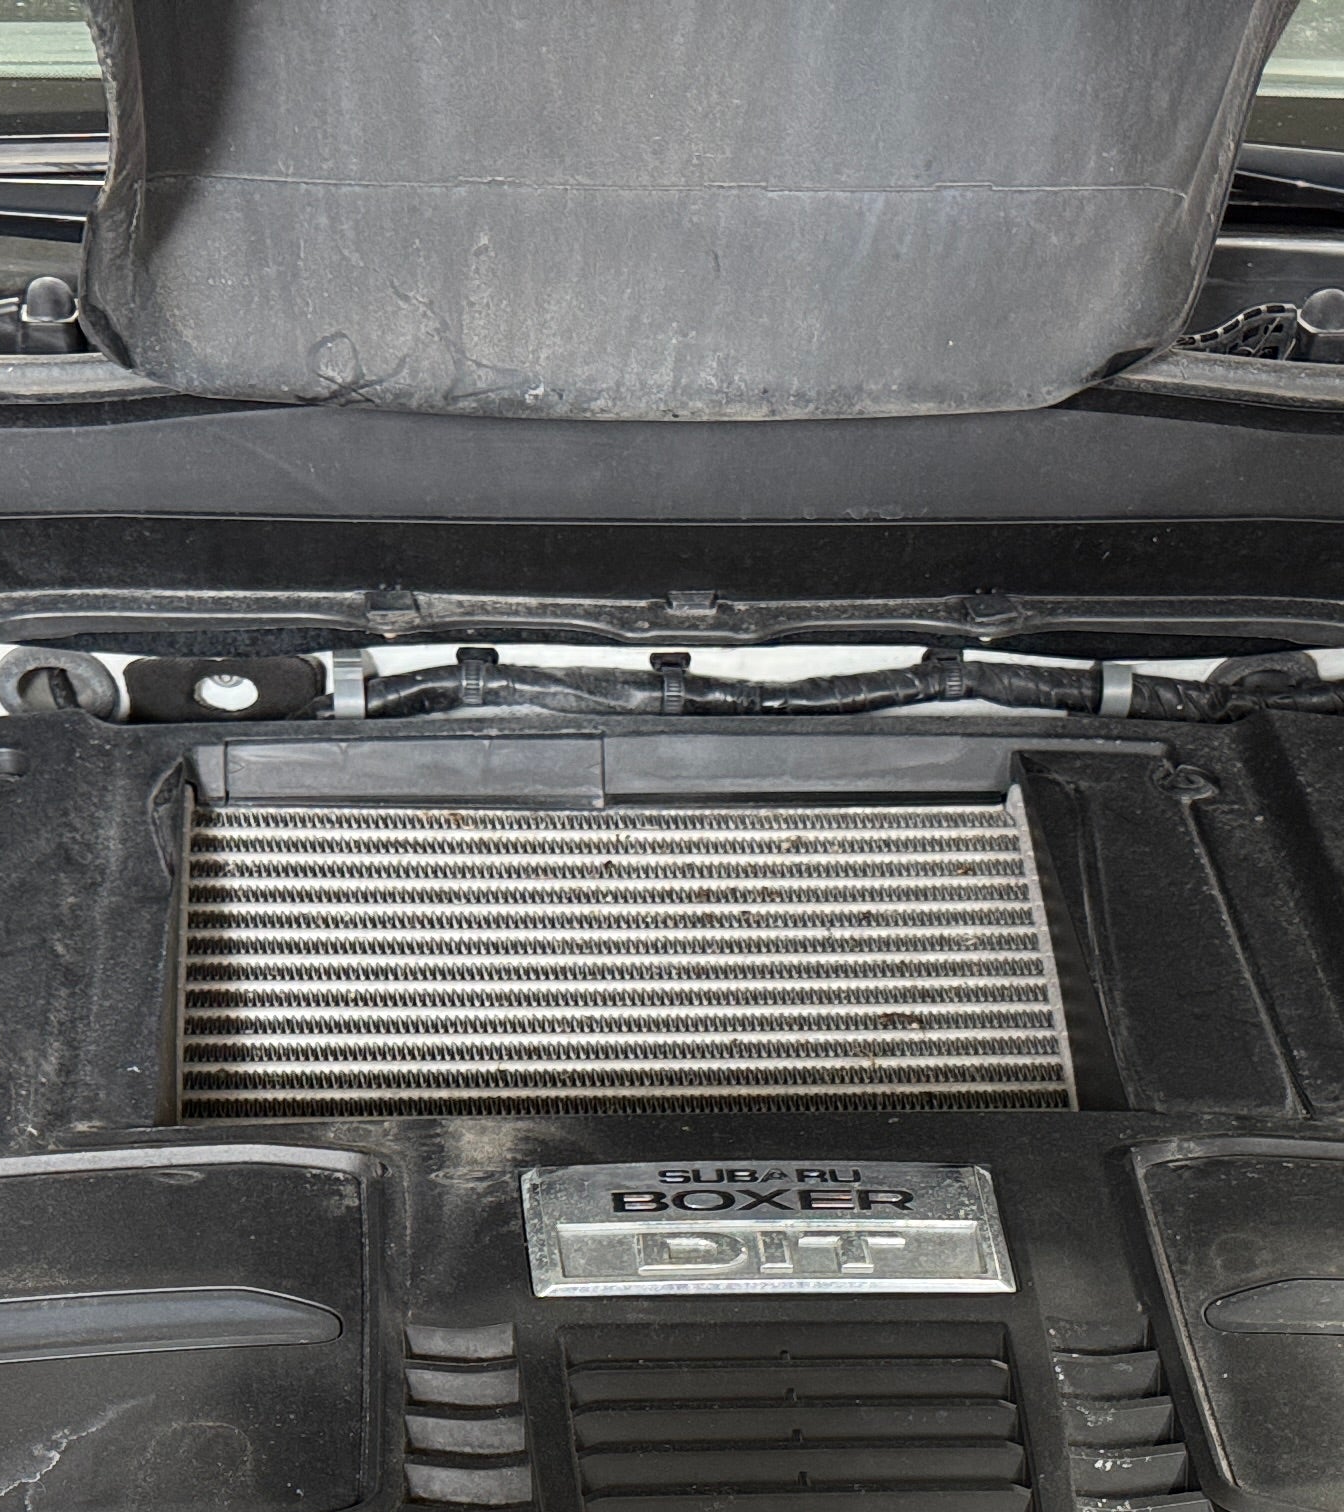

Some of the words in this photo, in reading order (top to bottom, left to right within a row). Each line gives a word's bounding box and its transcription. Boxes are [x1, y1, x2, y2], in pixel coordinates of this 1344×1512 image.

[658, 1168, 862, 1184] SUBARU
[611, 1188, 914, 1213] BOXER
[635, 1231, 906, 1274] DIT
